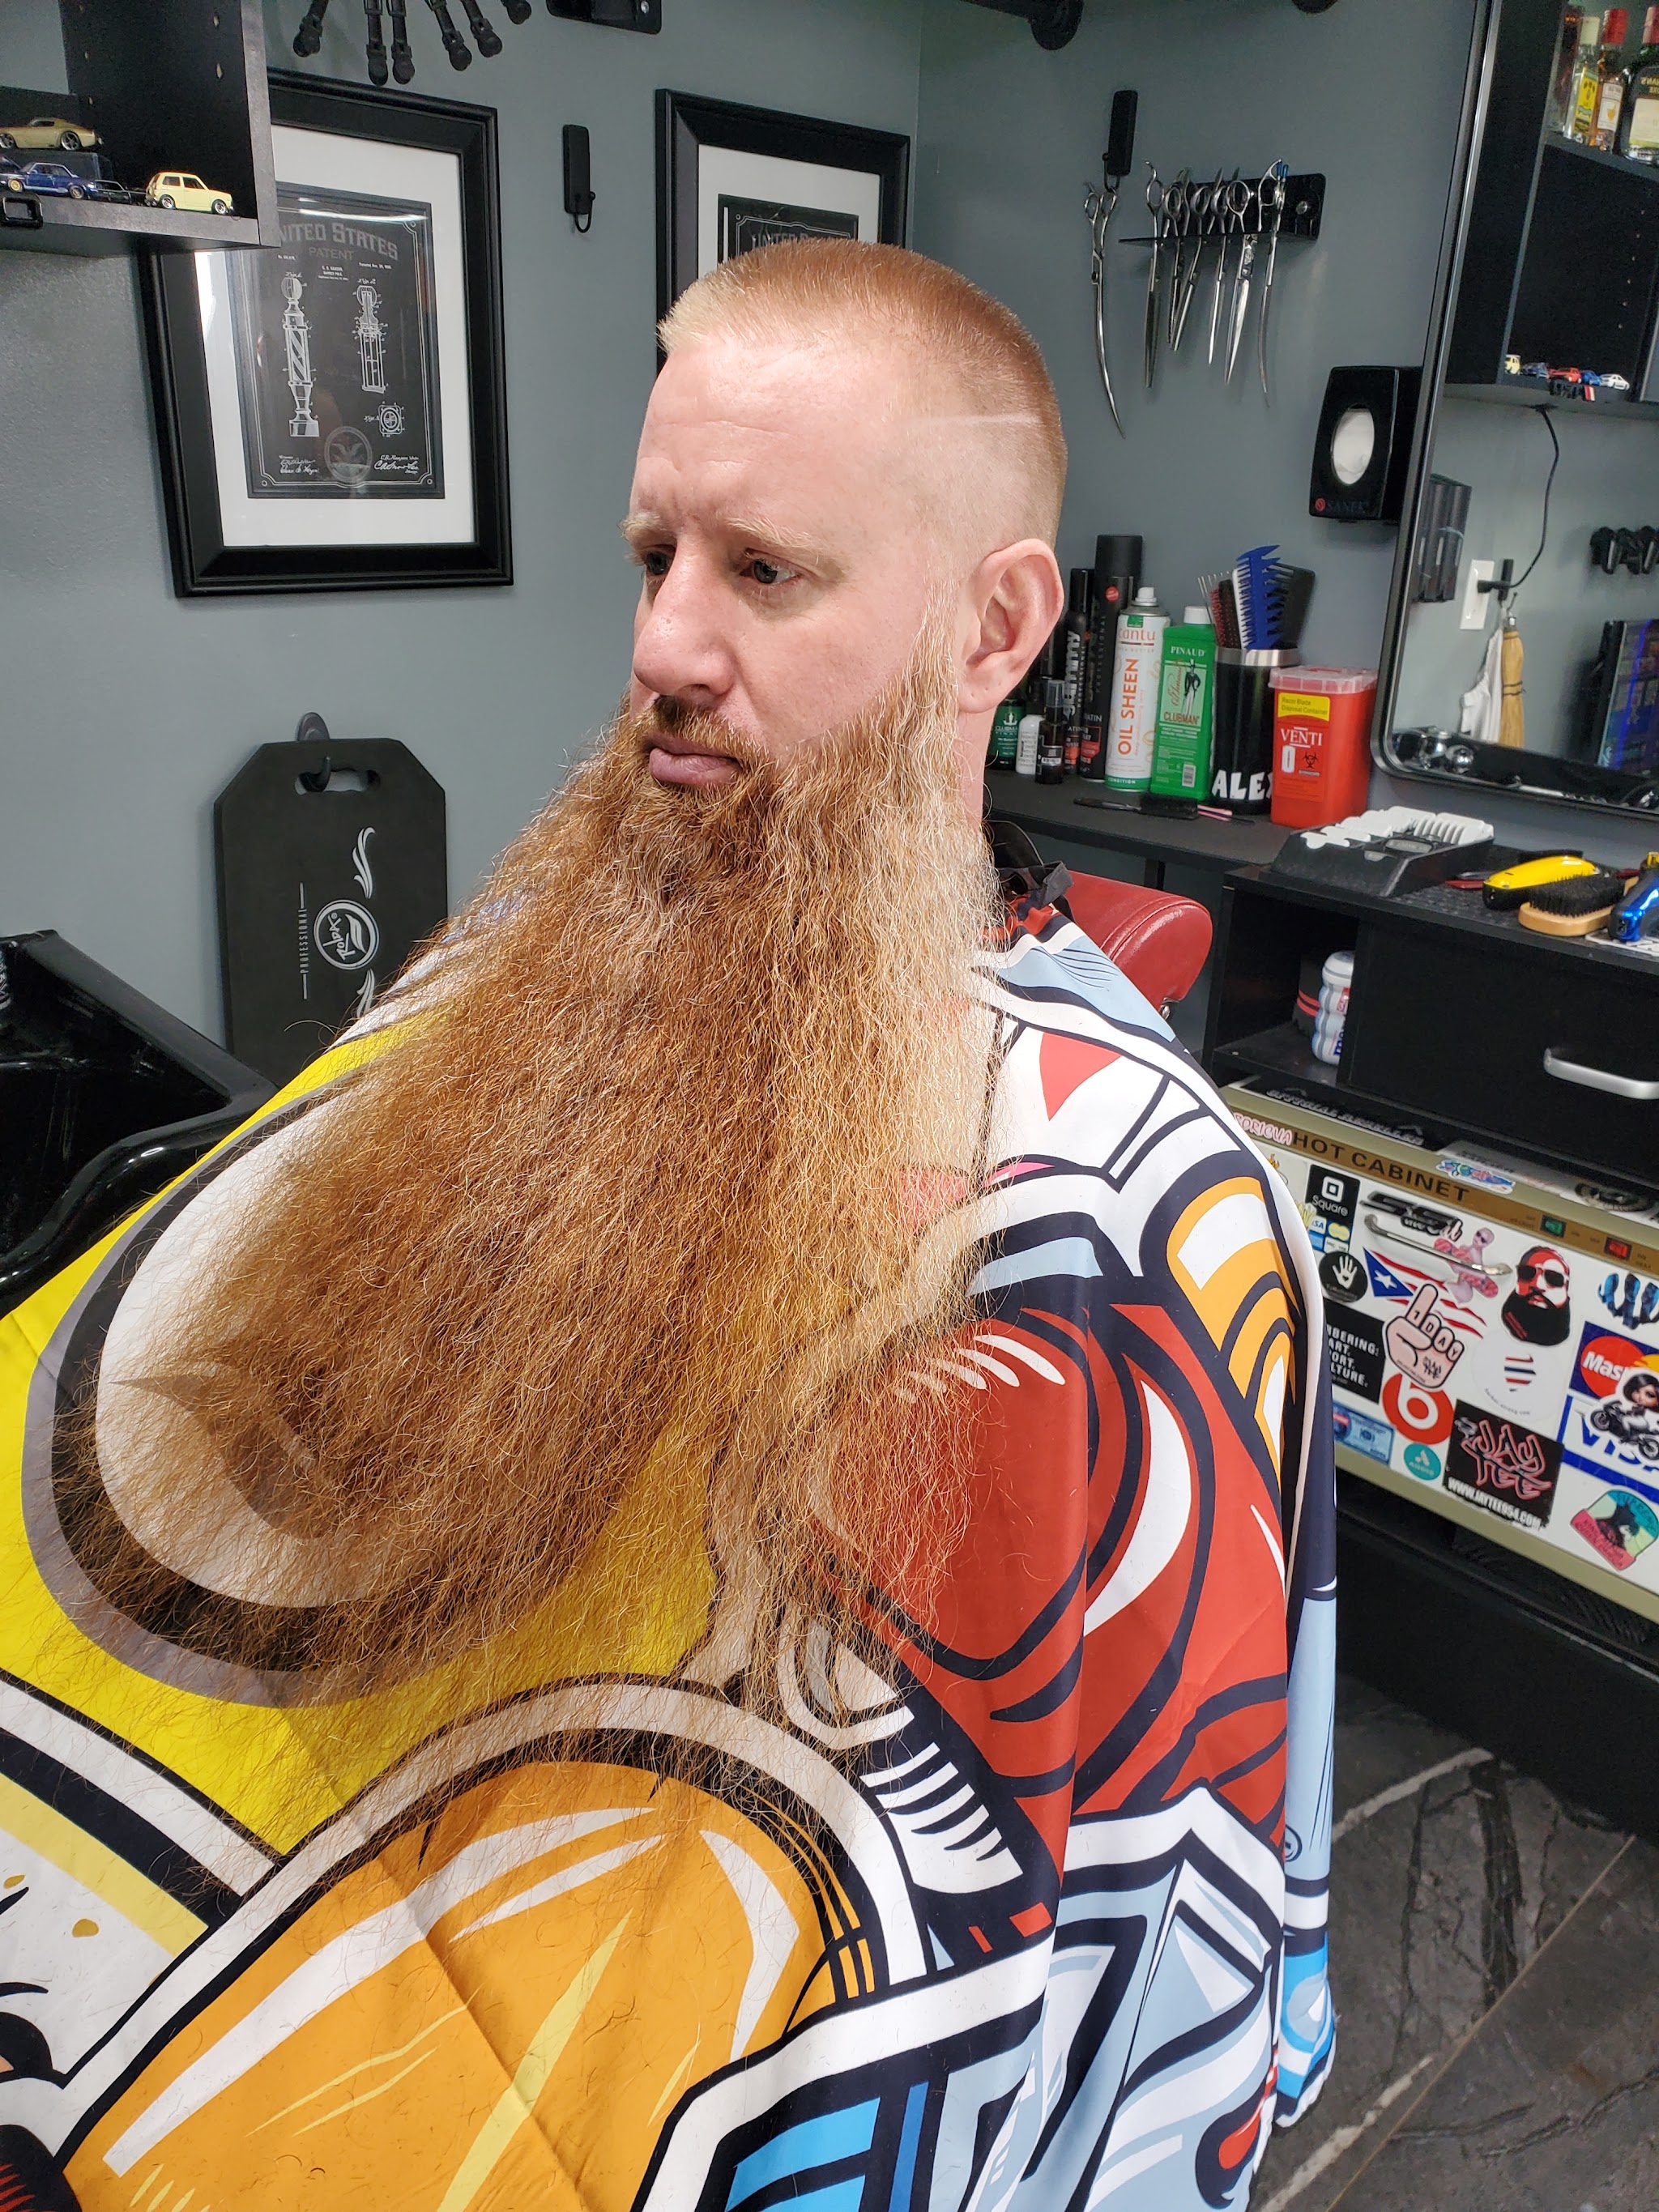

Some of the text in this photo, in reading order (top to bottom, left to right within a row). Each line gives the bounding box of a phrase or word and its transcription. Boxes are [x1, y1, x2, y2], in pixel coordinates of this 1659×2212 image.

[309, 246, 354, 261] PATENT
[332, 222, 399, 261] STATES
[1170, 646, 1205, 658] PINAUD
[1120, 658, 1140, 719] SHEEN
[1117, 725, 1133, 756] OIL
[1280, 727, 1323, 747] VENTI
[297, 908, 309, 974] PROFESSIONAL
[1293, 1132, 1346, 1160] HOT
[1351, 1153, 1471, 1203] CABINET
[1311, 1194, 1349, 1217] Square
